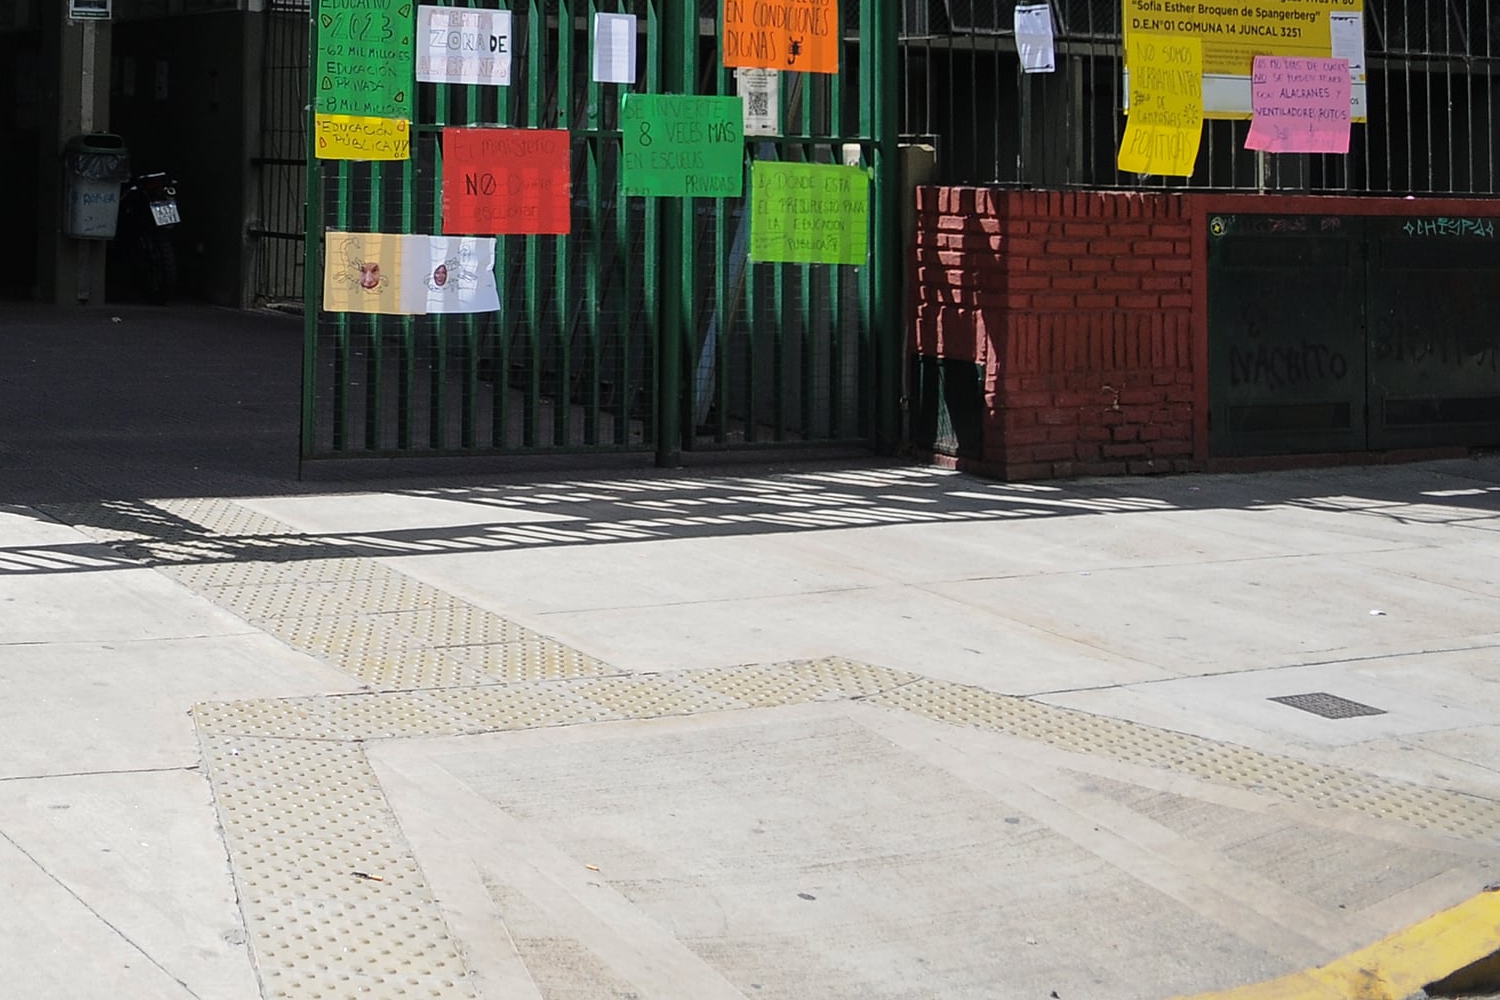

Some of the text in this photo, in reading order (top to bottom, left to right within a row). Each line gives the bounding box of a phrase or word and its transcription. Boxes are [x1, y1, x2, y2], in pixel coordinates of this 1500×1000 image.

[726, 0, 829, 36] EN CONDICIONES
[1165, 2, 1196, 13] Esther
[1198, 4, 1239, 19] Broquen
[1241, 6, 1254, 17] de
[330, 12, 394, 43] 2023
[1178, 20, 1223, 33] COMUNA
[1225, 23, 1236, 34] 14
[1238, 24, 1278, 37] JUNCAL
[1280, 26, 1302, 38] 3251
[429, 29, 508, 53] ZONA DE
[727, 29, 776, 61] DIGNAS
[349, 47, 365, 58] MIL
[1136, 42, 1155, 62] NO
[1162, 45, 1192, 65] SOMOS
[326, 60, 396, 77] EDUCACIÓN
[1307, 61, 1318, 71] DE
[334, 76, 384, 92] PRIVADA
[1254, 73, 1267, 82] NO
[1279, 87, 1330, 99] ALACRANES
[340, 99, 359, 113] MIL
[1156, 95, 1165, 110] DE
[322, 120, 393, 137] EDUCACIÓN
[639, 118, 736, 147] 8 VECES MÁS
[625, 152, 643, 170] EN
[685, 174, 734, 194] PRIVADAS
[757, 200, 769, 215] EL
[767, 218, 780, 230] LA
